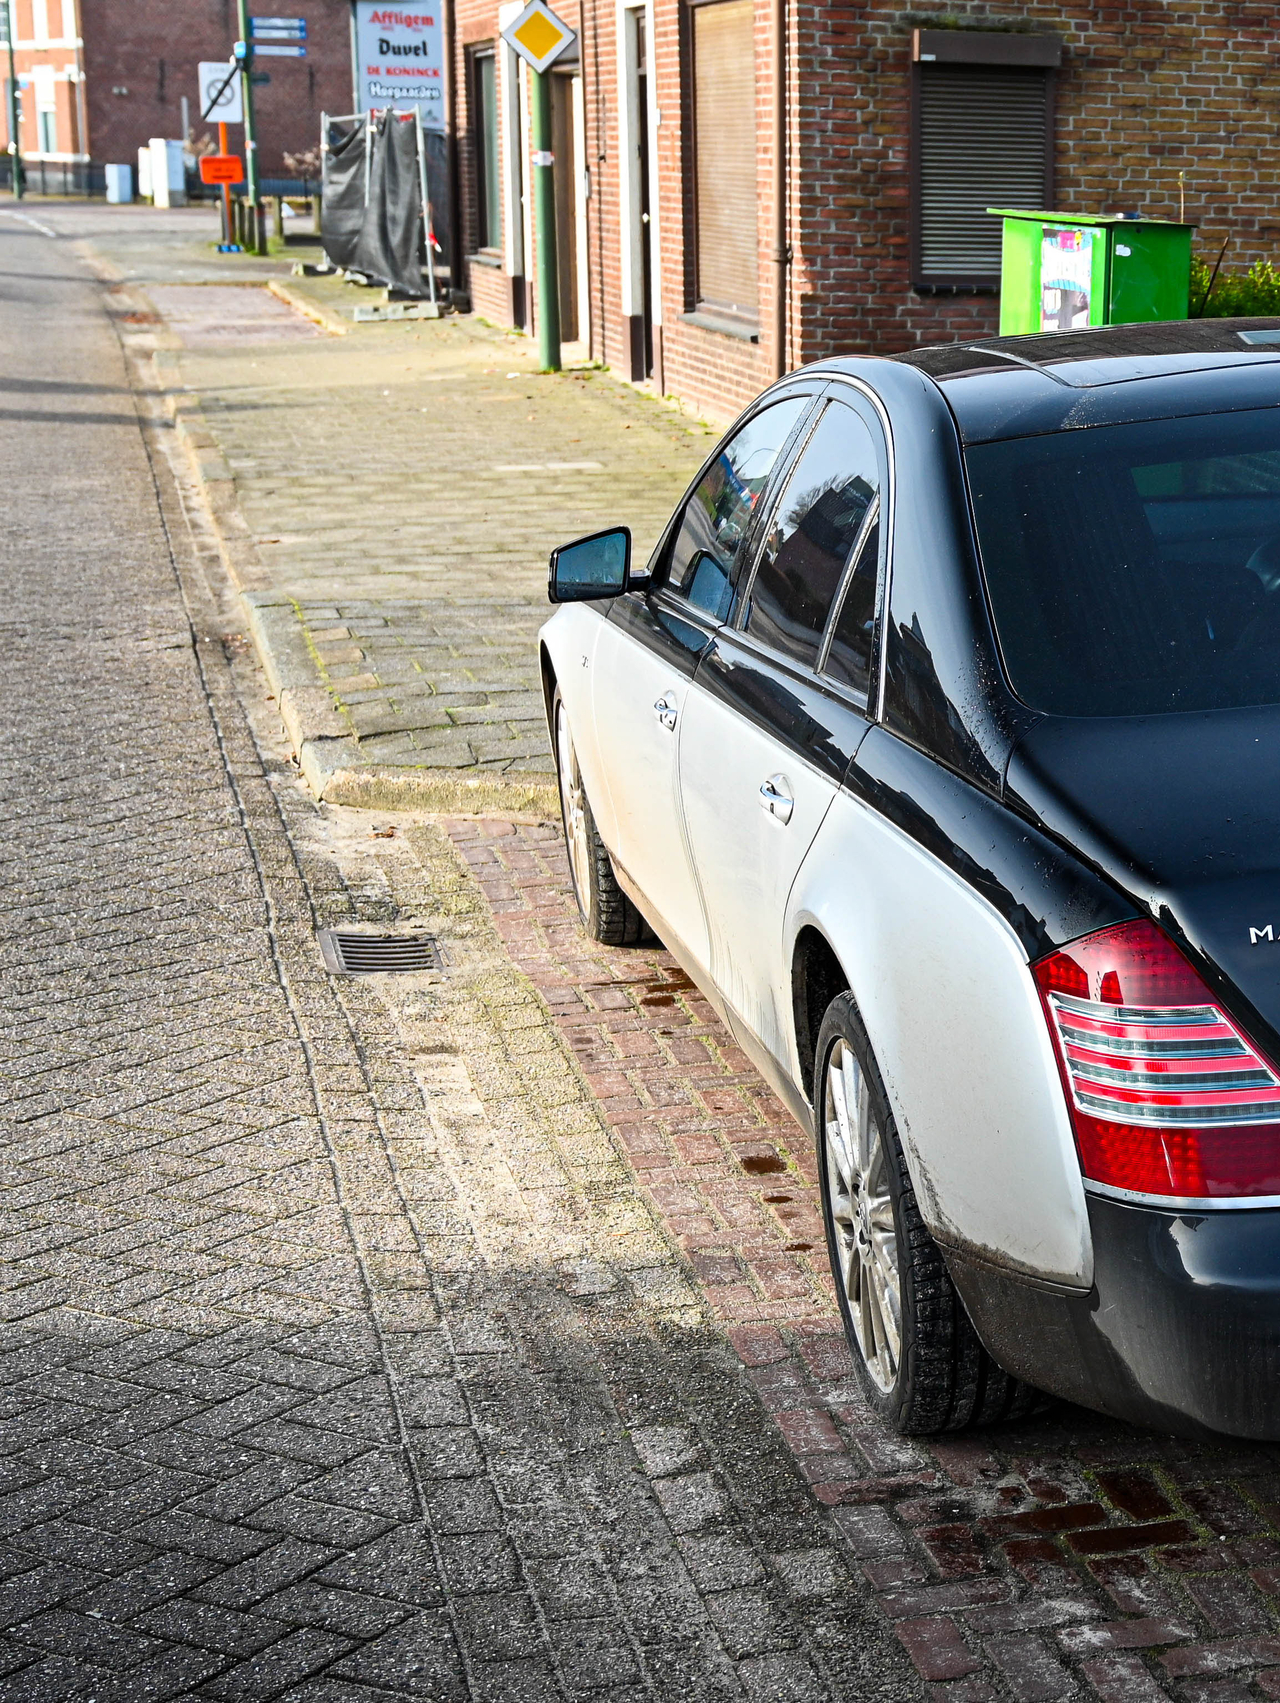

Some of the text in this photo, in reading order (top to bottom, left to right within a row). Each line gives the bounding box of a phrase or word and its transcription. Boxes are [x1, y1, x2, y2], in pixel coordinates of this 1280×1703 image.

[369, 10, 435, 28] Affligem
[378, 38, 428, 56] Duvel
[367, 66, 440, 77] DE KONINCK
